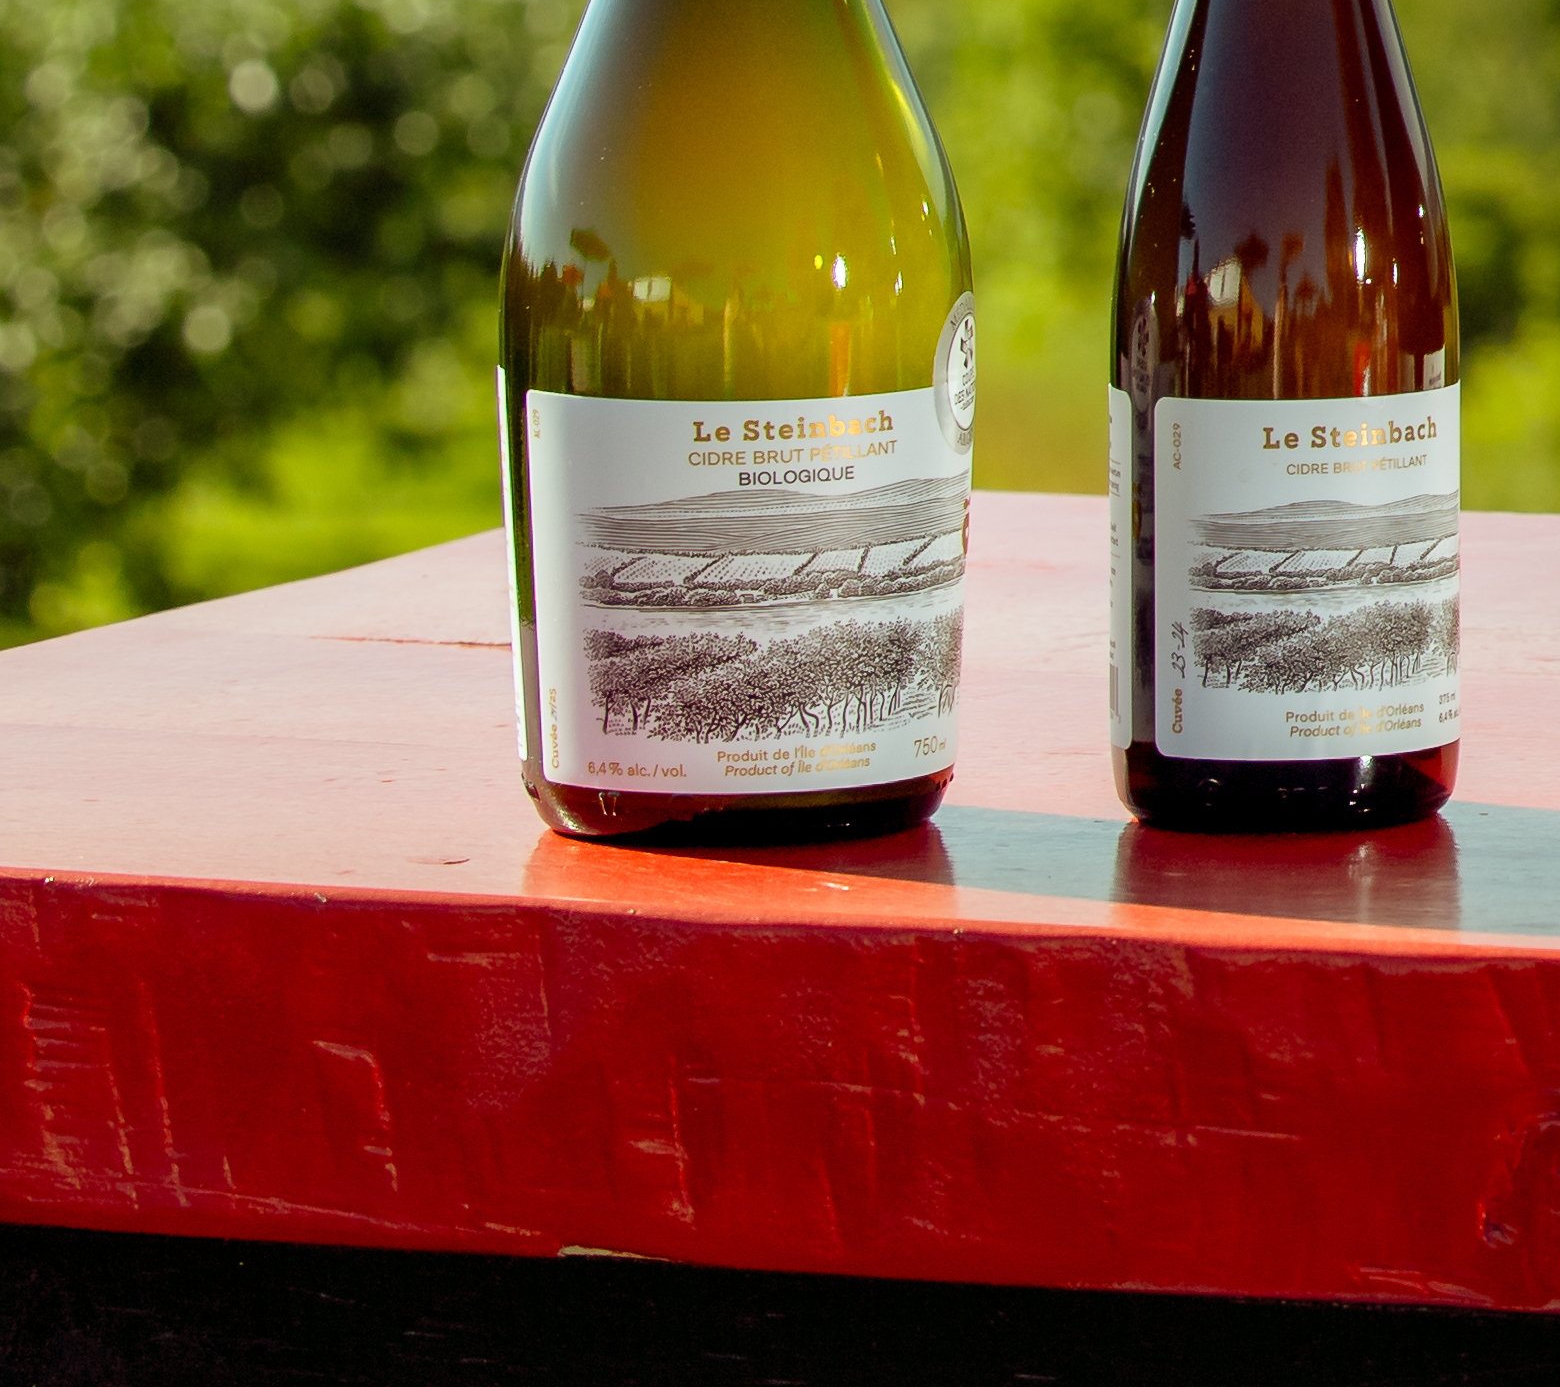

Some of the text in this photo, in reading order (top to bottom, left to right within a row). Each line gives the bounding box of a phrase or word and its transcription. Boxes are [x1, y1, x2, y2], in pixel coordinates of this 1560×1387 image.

[693, 411, 893, 442] Le Steinbach
[1263, 417, 1437, 449] Le Steinbach
[688, 440, 897, 466] CIDRE BRUT PÉTILLANT
[1286, 455, 1427, 475] CIDRE BRUT PÉTILLANT
[739, 467, 855, 486] BIOLOGIQUE
[1172, 688, 1182, 734] Cuvée
[549, 724, 560, 769] Cuvée
[717, 749, 770, 762] Produit
[774, 748, 792, 761] de
[725, 763, 775, 777] Product
[779, 760, 795, 776] of
